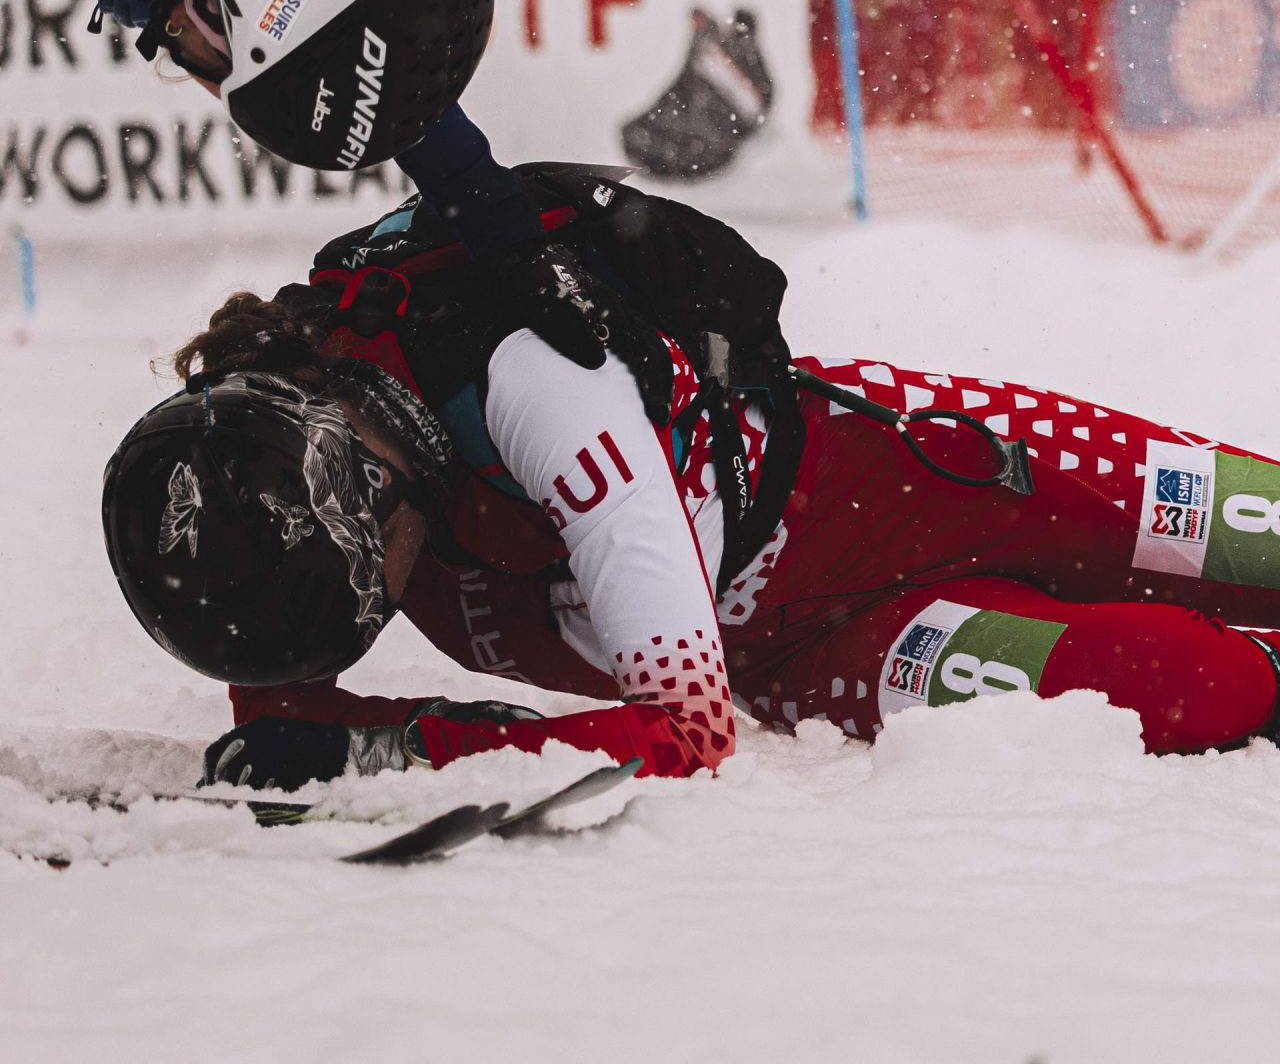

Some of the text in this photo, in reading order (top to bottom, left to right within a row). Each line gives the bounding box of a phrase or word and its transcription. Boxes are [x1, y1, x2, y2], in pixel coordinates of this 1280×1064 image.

[311, 77, 335, 132] Julbo
[336, 26, 387, 169] DYNAFIT
[0, 119, 414, 204] WORKW
[733, 455, 748, 509] CAMP
[1178, 472, 1191, 502] ISMF
[913, 629, 934, 657] ISMF
